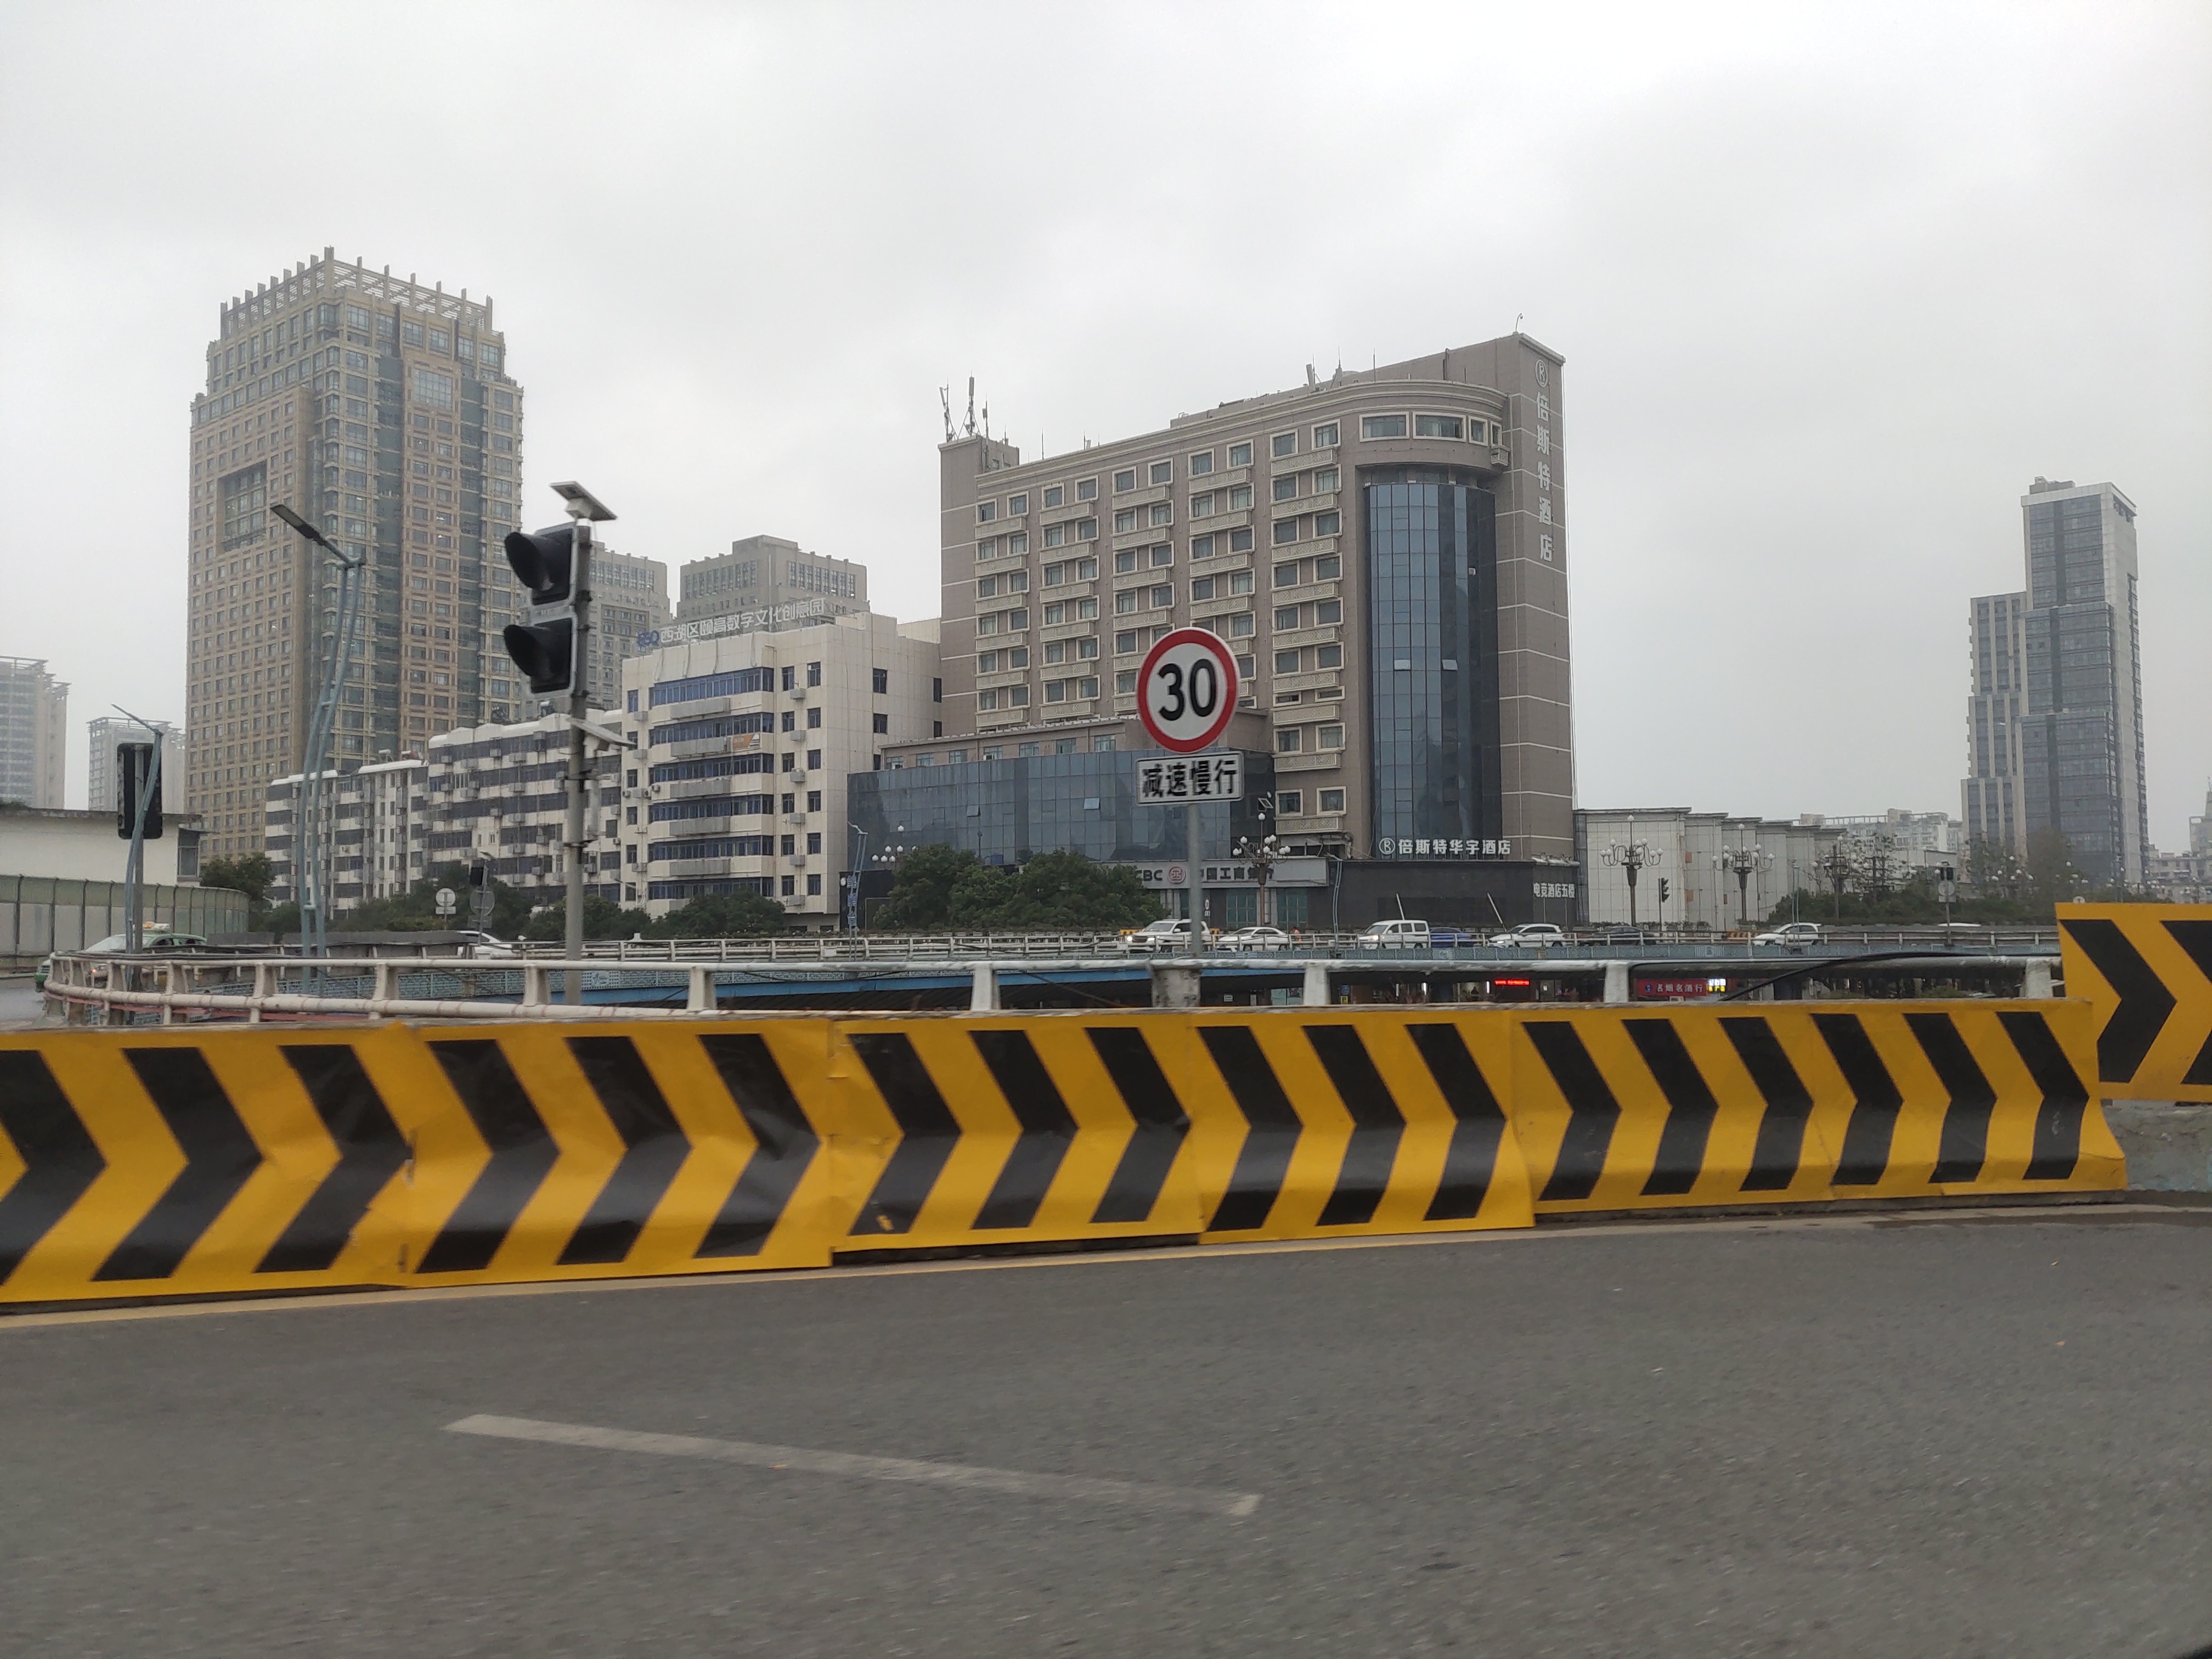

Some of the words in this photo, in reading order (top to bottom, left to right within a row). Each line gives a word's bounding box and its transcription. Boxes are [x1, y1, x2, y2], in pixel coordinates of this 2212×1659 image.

[1536, 391, 1553, 563] 倍斯特酒店
[1158, 658, 1216, 721] 30
[1141, 759, 1237, 798] 减速慢行
[1398, 839, 1511, 855] 倍斯特华宇酒店
